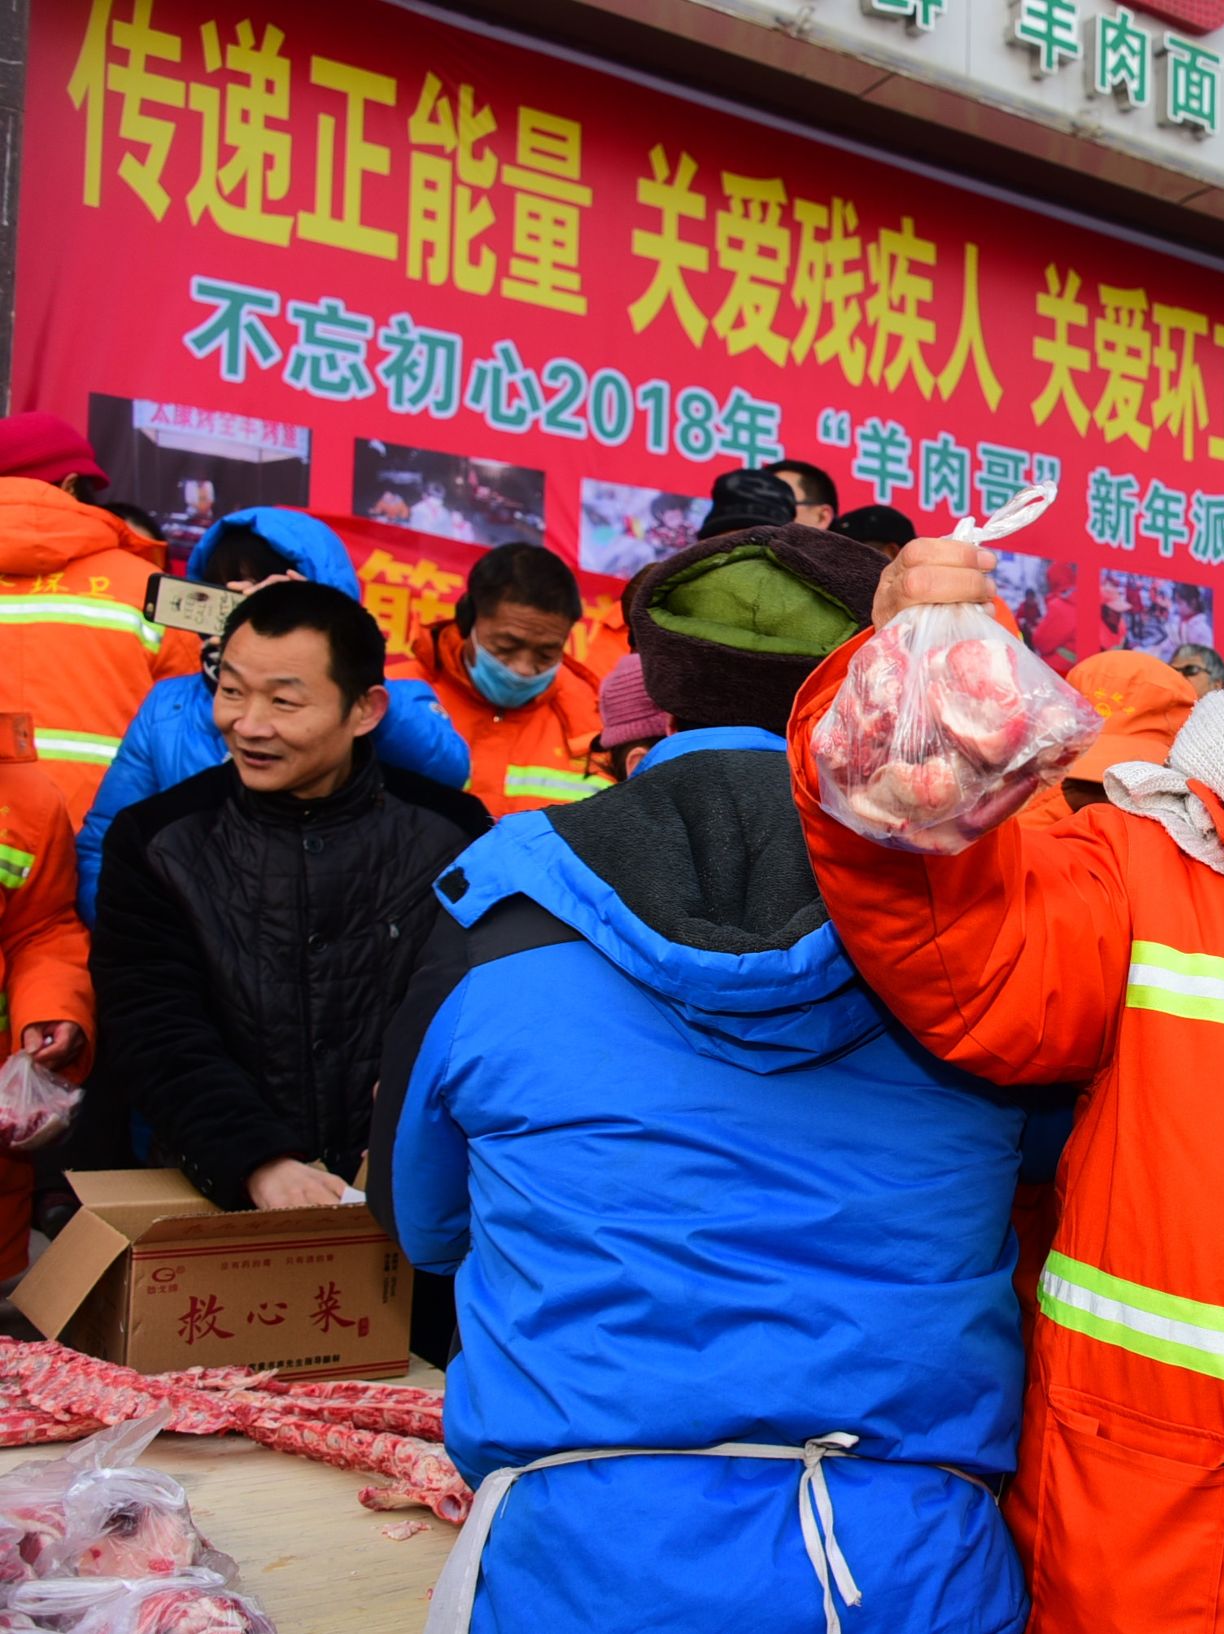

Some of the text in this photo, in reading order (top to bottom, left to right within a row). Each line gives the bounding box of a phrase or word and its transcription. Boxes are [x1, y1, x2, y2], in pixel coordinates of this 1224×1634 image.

[66, 0, 593, 316] 传递正能量
[627, 142, 1004, 414] 关爱残疾人
[183, 275, 784, 469] 不忘初心2018年
[176, 1281, 356, 1346] 救心菜
